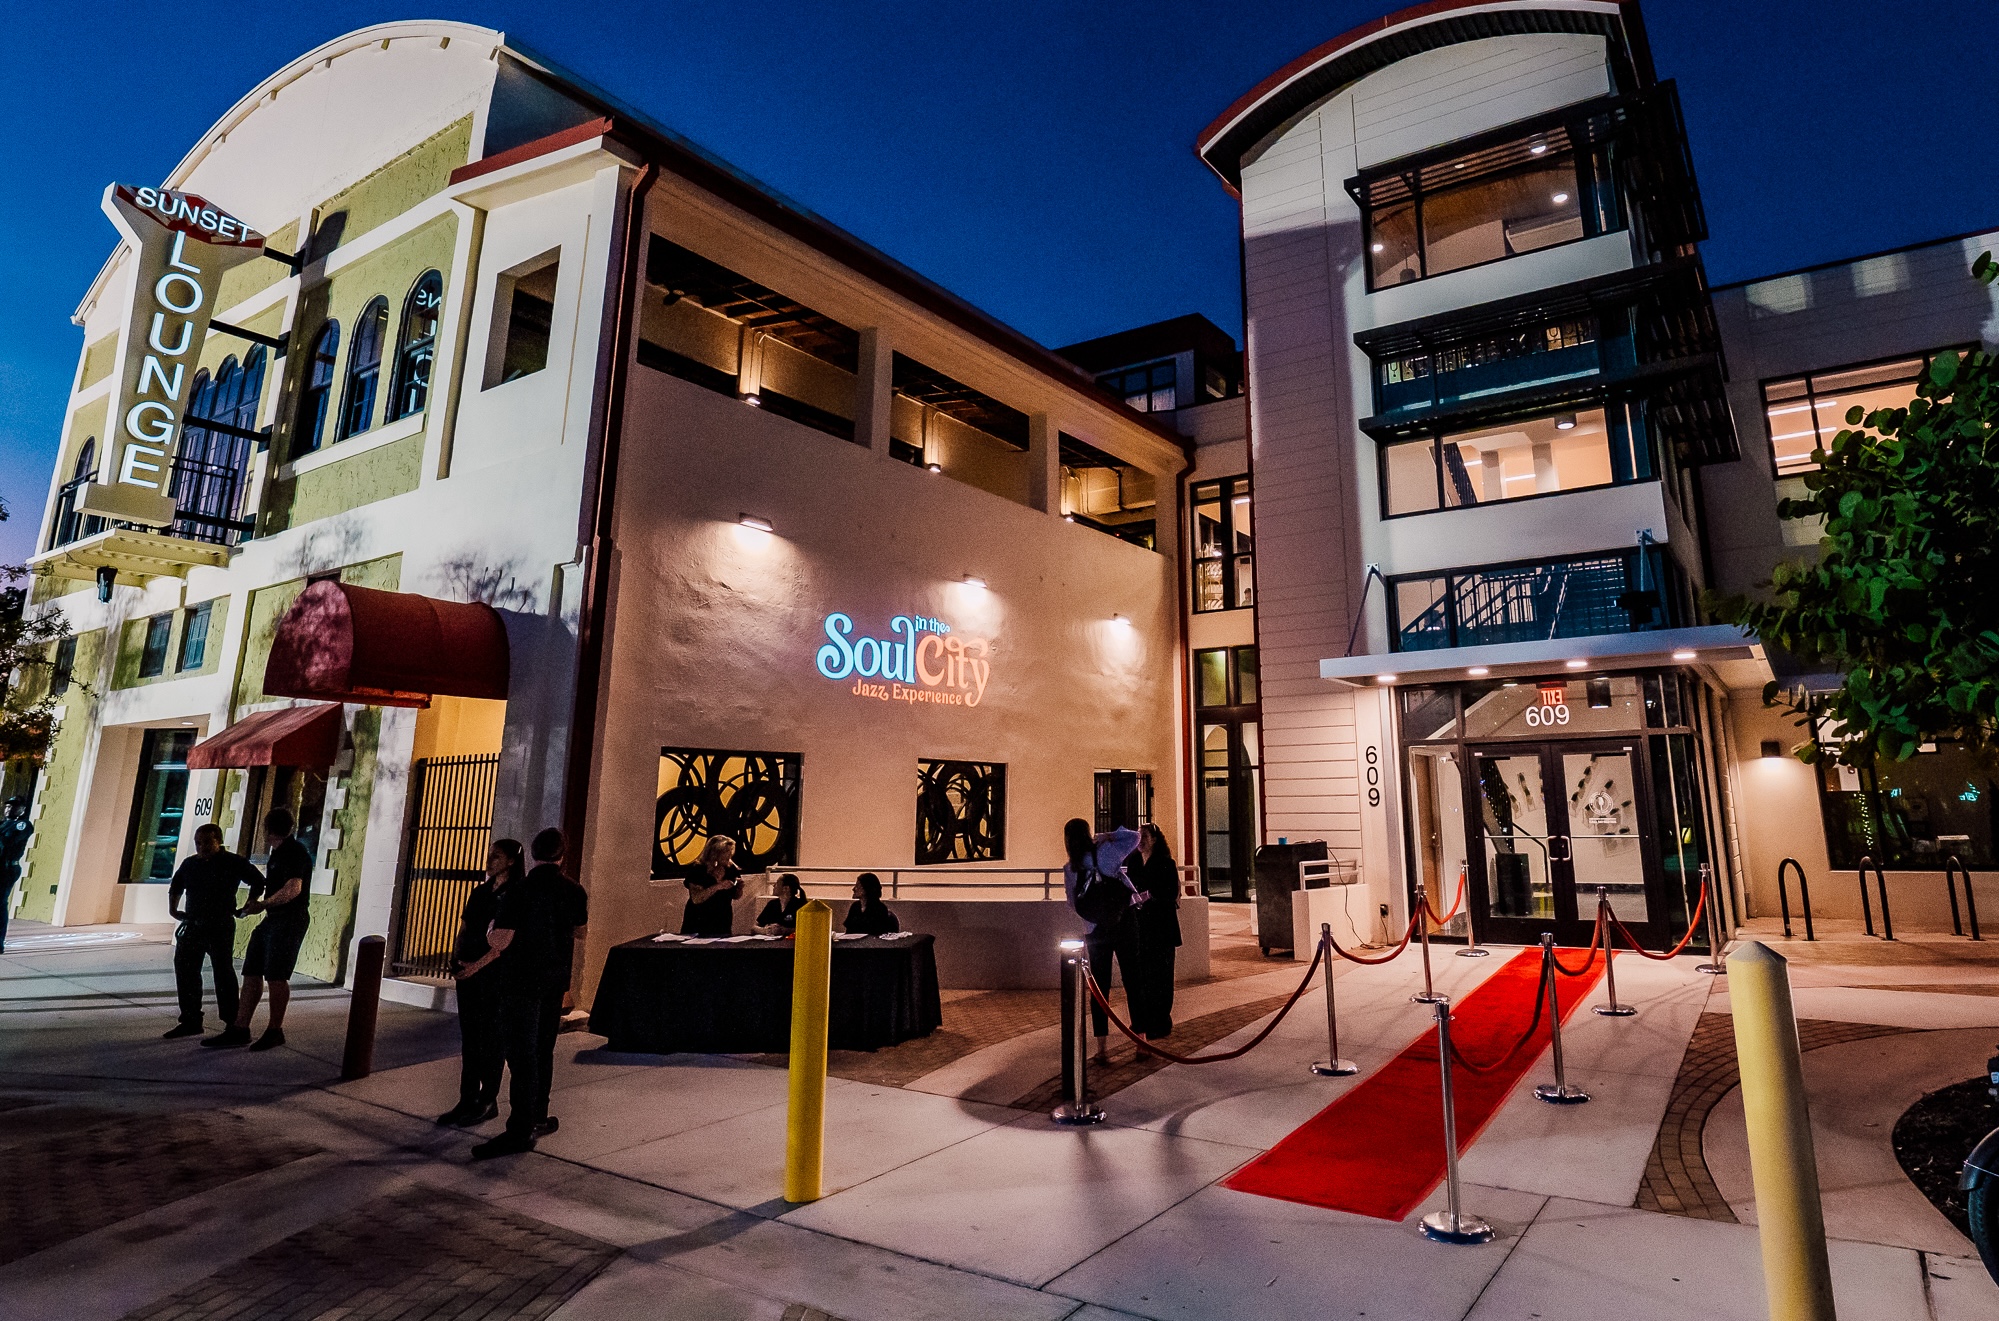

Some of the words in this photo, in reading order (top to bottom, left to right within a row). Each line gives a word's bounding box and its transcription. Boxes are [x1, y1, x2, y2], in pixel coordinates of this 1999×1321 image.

[135, 186, 254, 243] SUNSET
[119, 230, 204, 489] LOUNGE
[915, 615, 927, 632] in
[929, 617, 951, 636] the
[816, 612, 916, 684] Soul
[852, 679, 889, 701] Jazz
[892, 684, 962, 705] Experience
[916, 635, 990, 708] City
[1526, 705, 1570, 727] 609
[1366, 745, 1380, 807] 609
[194, 798, 213, 816] 609
